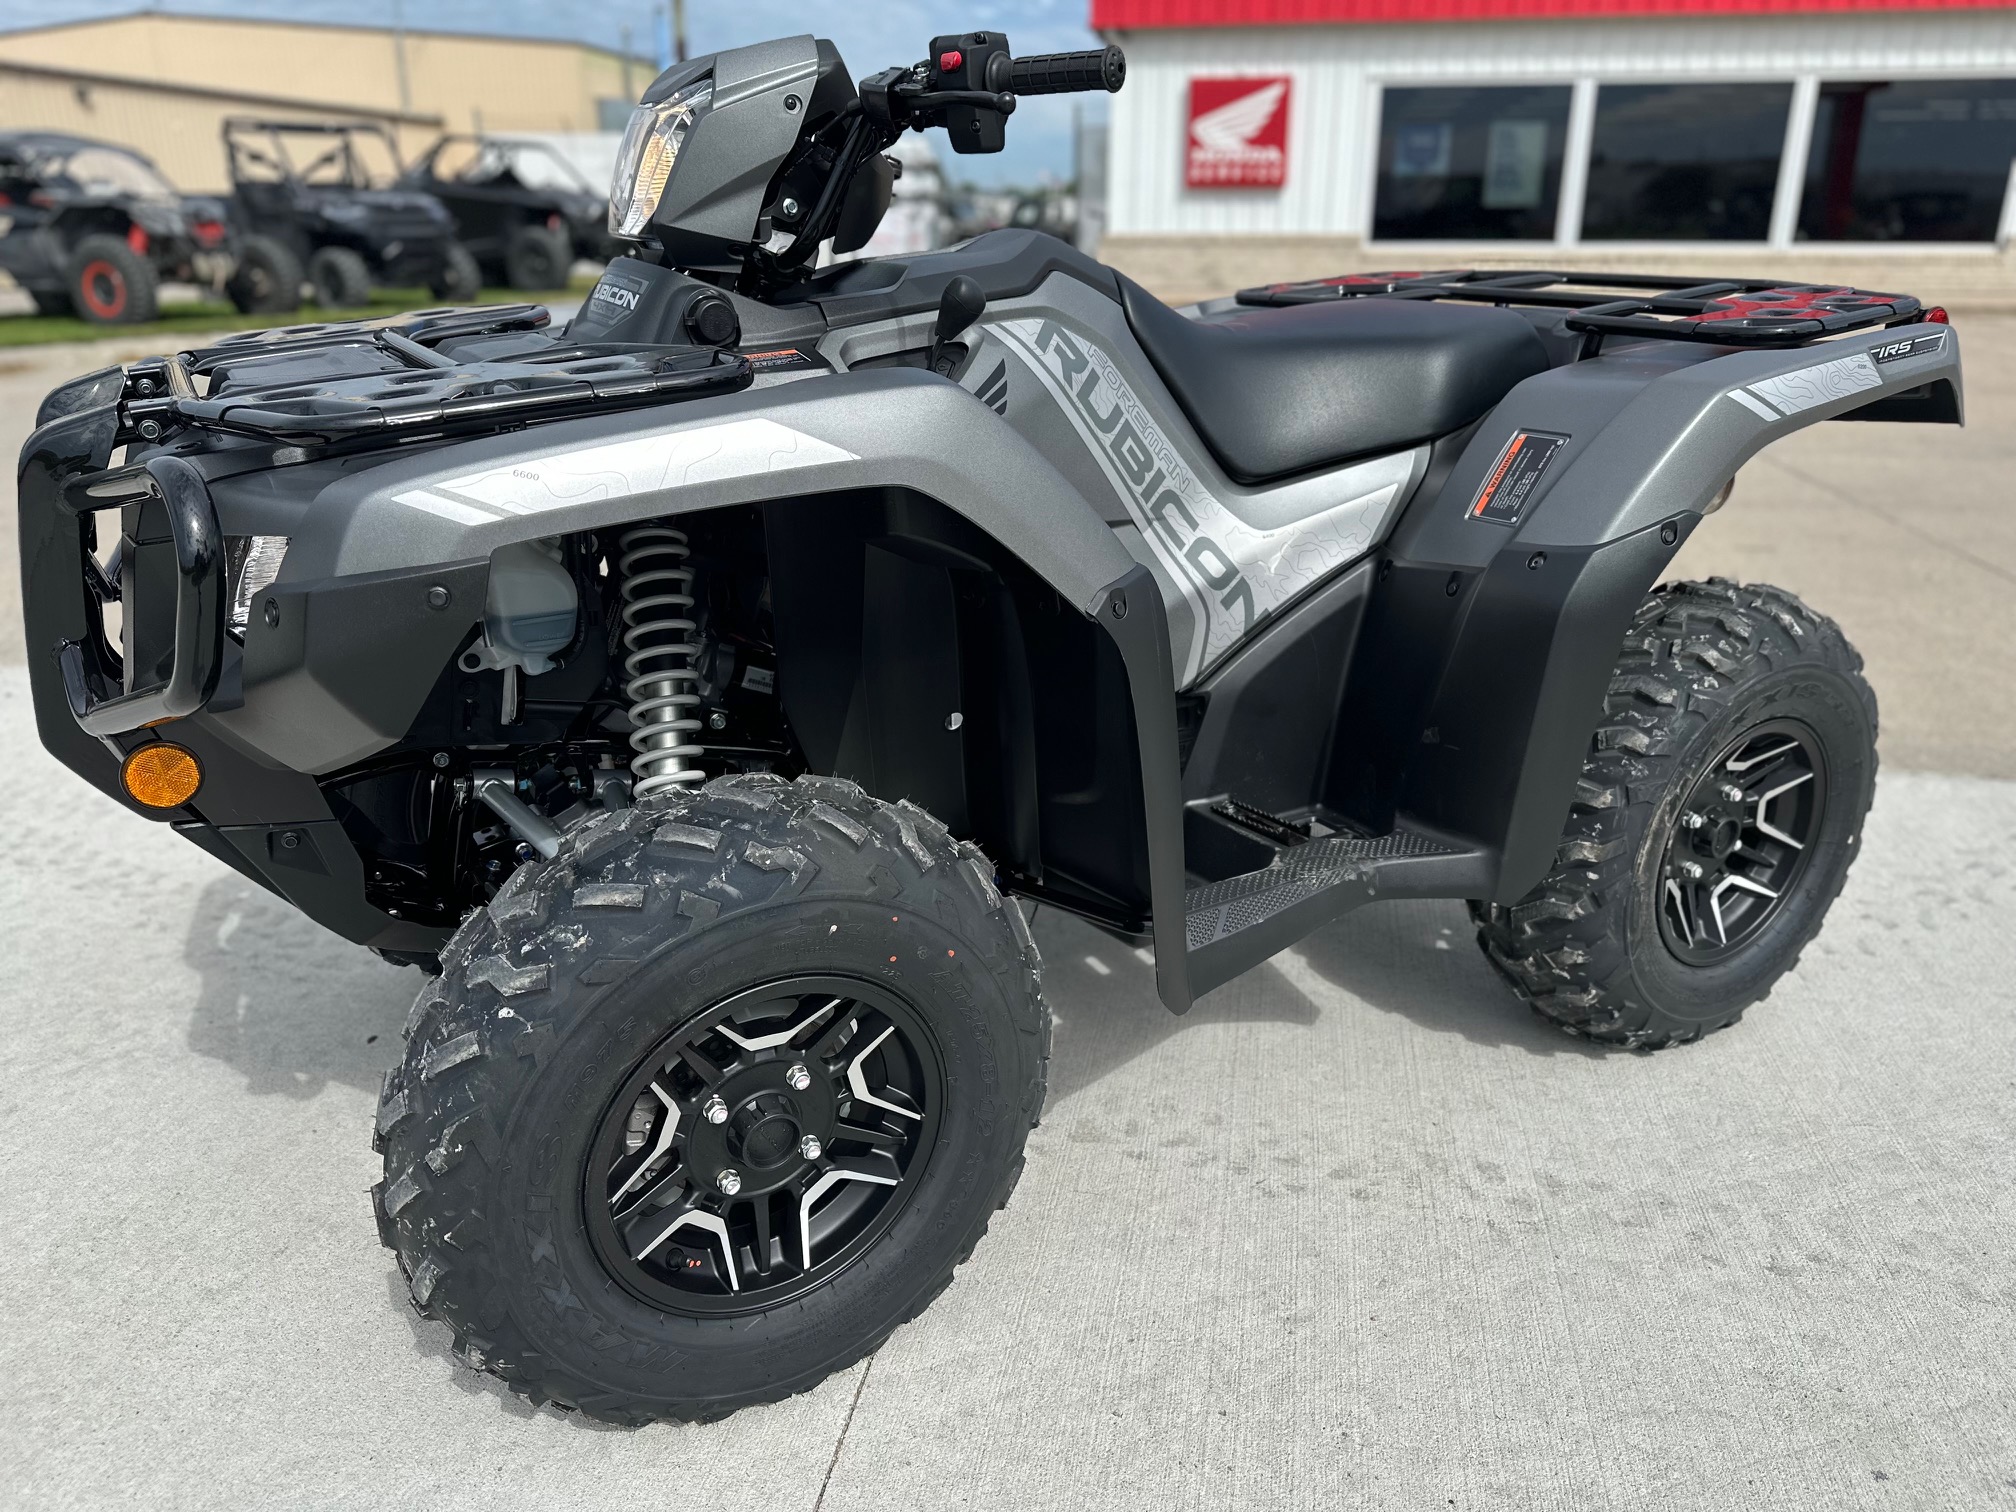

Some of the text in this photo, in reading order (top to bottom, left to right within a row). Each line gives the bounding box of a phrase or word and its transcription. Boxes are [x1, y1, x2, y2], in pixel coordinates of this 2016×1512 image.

[1879, 341, 1912, 358] IRS
[1087, 342, 1190, 494] FOREMAN
[512, 469, 540, 481] 6600
[1034, 320, 1271, 638] RUBICON
[1489, 451, 1516, 490] WARNING
[523, 1132, 689, 1374] MAXXIS
